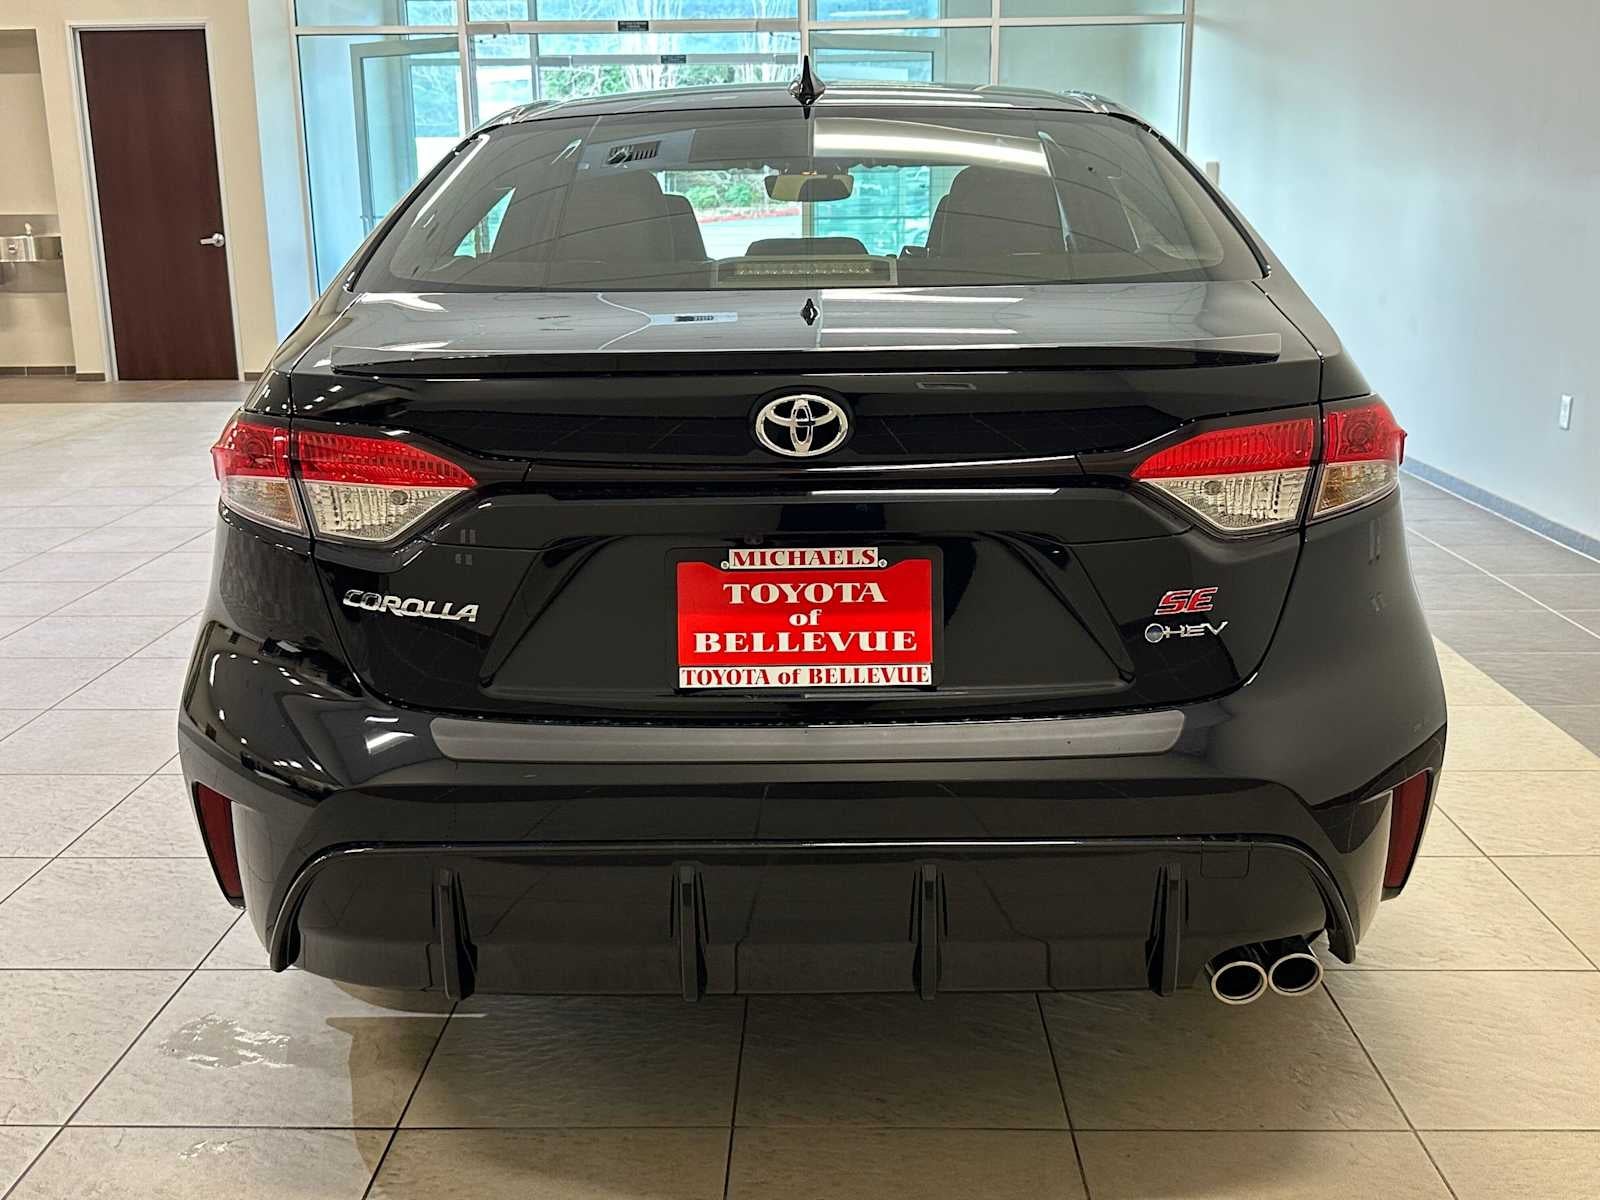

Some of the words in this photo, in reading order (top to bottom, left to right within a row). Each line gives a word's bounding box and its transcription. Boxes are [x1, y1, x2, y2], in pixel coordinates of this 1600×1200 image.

[733, 549, 875, 567] MICHAELS
[723, 582, 888, 604] TOYOTA
[1154, 586, 1218, 616] SE
[342, 589, 480, 623] COROLLA
[789, 609, 822, 626] of
[1164, 621, 1229, 639] HEV
[694, 631, 917, 653] BELLEVUE
[681, 668, 770, 686] TOYOTA
[777, 668, 801, 685] of
[808, 666, 929, 684] BELLEVUE
